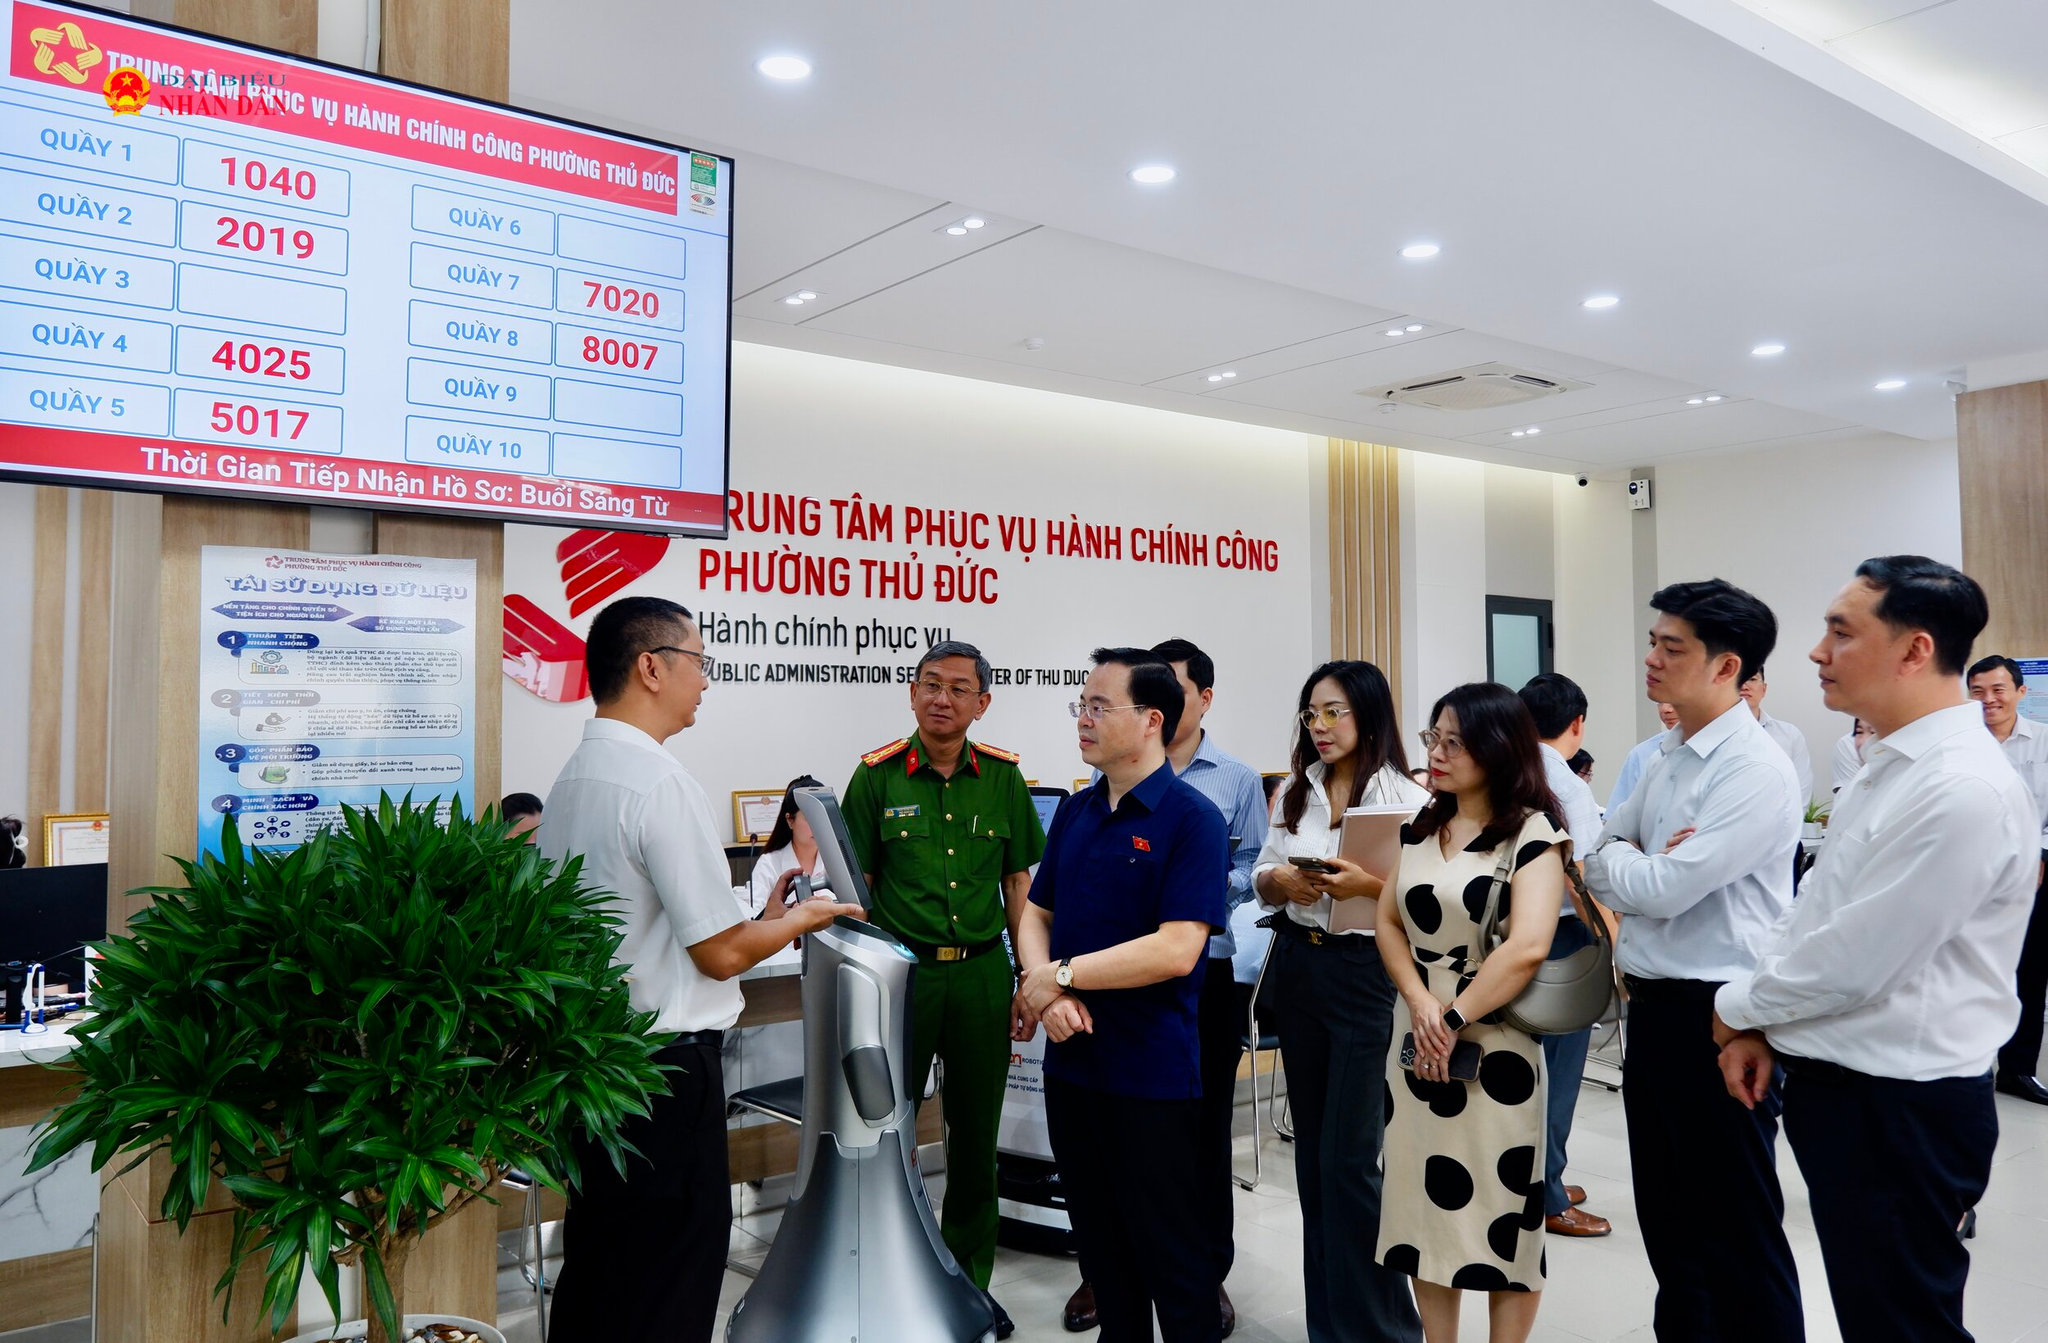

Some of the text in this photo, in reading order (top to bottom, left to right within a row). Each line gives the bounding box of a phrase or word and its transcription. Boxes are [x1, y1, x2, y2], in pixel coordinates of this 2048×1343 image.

[40, 127, 132, 162] QUẦY 1
[311, 97, 339, 127] VỤ
[345, 104, 401, 137] HÀNH
[406, 117, 467, 151] CHÍNH
[472, 132, 523, 163] CÔNG
[528, 145, 602, 181] PHƯỜNG
[605, 161, 638, 188] THỦ
[642, 169, 677, 197] ĐỨC
[220, 156, 318, 201] 1040
[37, 192, 133, 226] QUẦY 2
[449, 206, 522, 236] QUẦY 6
[216, 216, 315, 259] 2019
[34, 257, 130, 289] QUẦY 3
[447, 264, 520, 291] QUẦY 7
[583, 280, 660, 319] 7020
[31, 322, 128, 353] QUẦY 4
[445, 320, 519, 348] QUẦY 8
[211, 340, 312, 380] 4025
[582, 335, 659, 371] 8007
[29, 387, 126, 417] QUẦY 5
[444, 376, 518, 403] QUẦY 9
[210, 401, 310, 440] 5017
[436, 433, 522, 460] QUẦY 10
[140, 446, 671, 517] Thời Gian Tiếp Nhận Hồ Sơ: Buổi Sáng Từ
[729, 490, 1279, 573] RUNG TÂM PHỤC VỤ HÀNH CHÍNH CÔNG
[307, 579, 378, 598] DỤNG
[699, 544, 999, 605] PHƯỜNG THỦ ĐỨC
[228, 635, 236, 645] 1
[699, 611, 768, 646] Hành
[775, 614, 848, 648] chính
[855, 618, 917, 655] phục
[710, 663, 761, 682] UBLIC
[764, 663, 892, 684] ADMINISTRATION
[1016, 668, 1033, 685] OF
[1035, 669, 1061, 686] THU
[221, 693, 233, 704] 2
[225, 748, 236, 758] 3
[221, 799, 233, 809] 4
